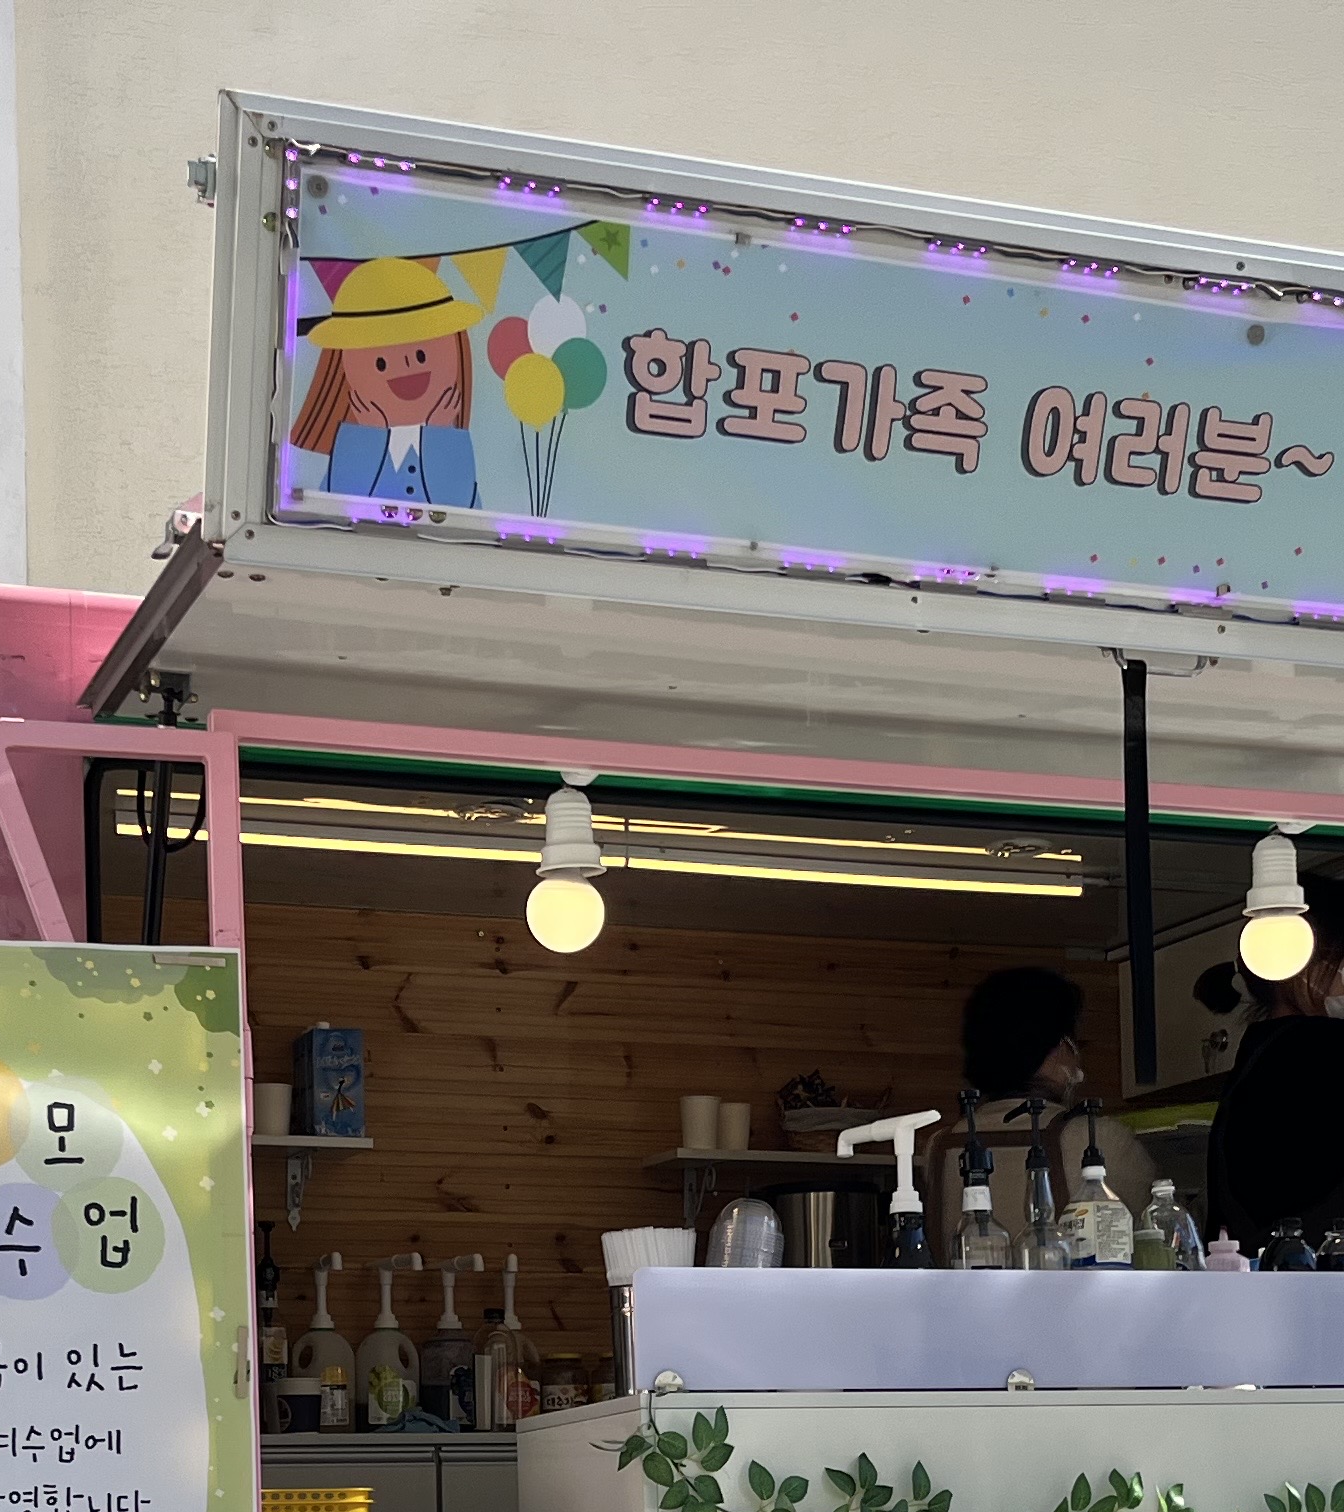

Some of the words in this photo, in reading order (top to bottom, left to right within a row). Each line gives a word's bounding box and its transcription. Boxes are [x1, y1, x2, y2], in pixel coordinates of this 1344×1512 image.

[622, 328, 989, 474] 합포가족
[1021, 384, 1335, 504] 여러분~
[67, 1343, 143, 1392] 있는
